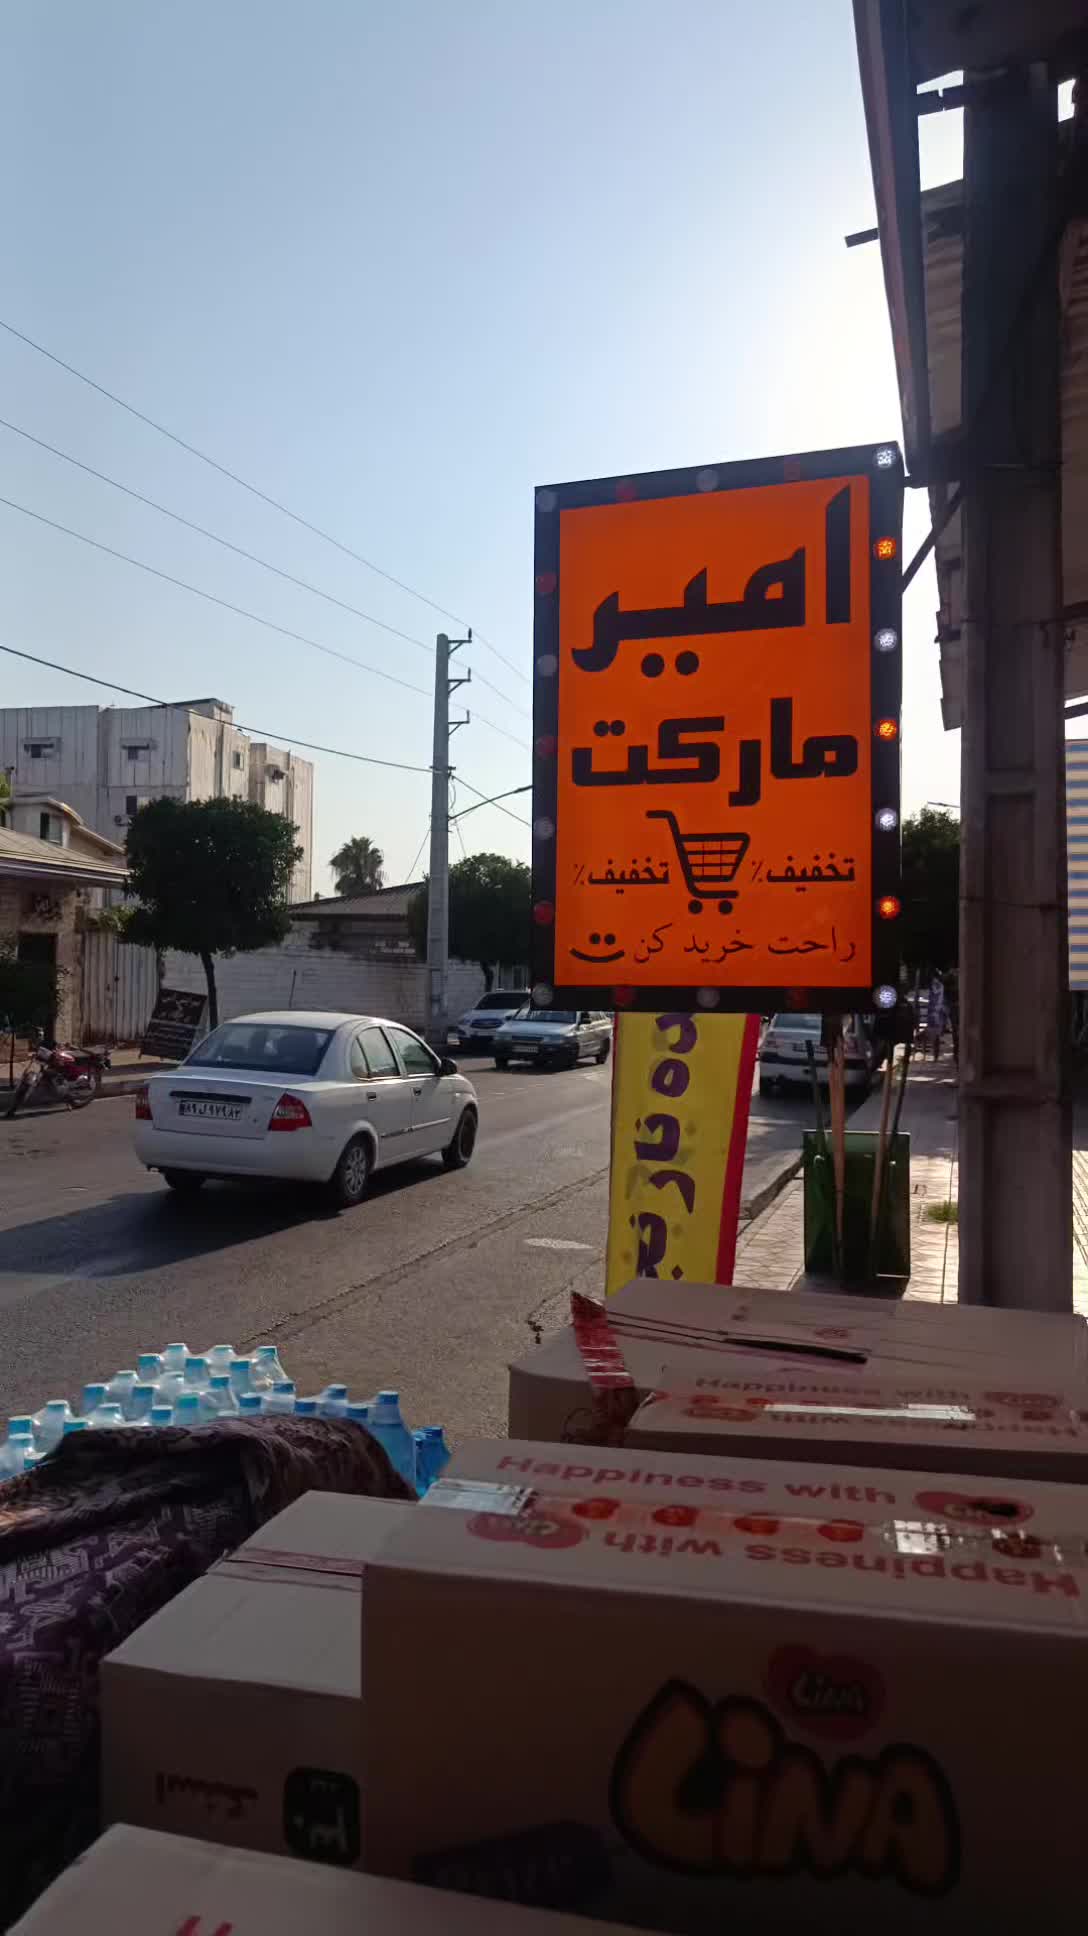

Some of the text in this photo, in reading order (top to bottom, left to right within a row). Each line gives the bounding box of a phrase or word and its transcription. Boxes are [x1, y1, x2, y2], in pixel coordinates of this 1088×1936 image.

[571, 484, 851, 679] امیر
[571, 697, 858, 807] مارکت
[587, 857, 670, 895] تخفیف
[766, 852, 856, 892] تخفیف
[632, 922, 856, 964] راحت خرید کن
[496, 1455, 896, 1504] Happiness with
[603, 1530, 1080, 1598] Happiness with
